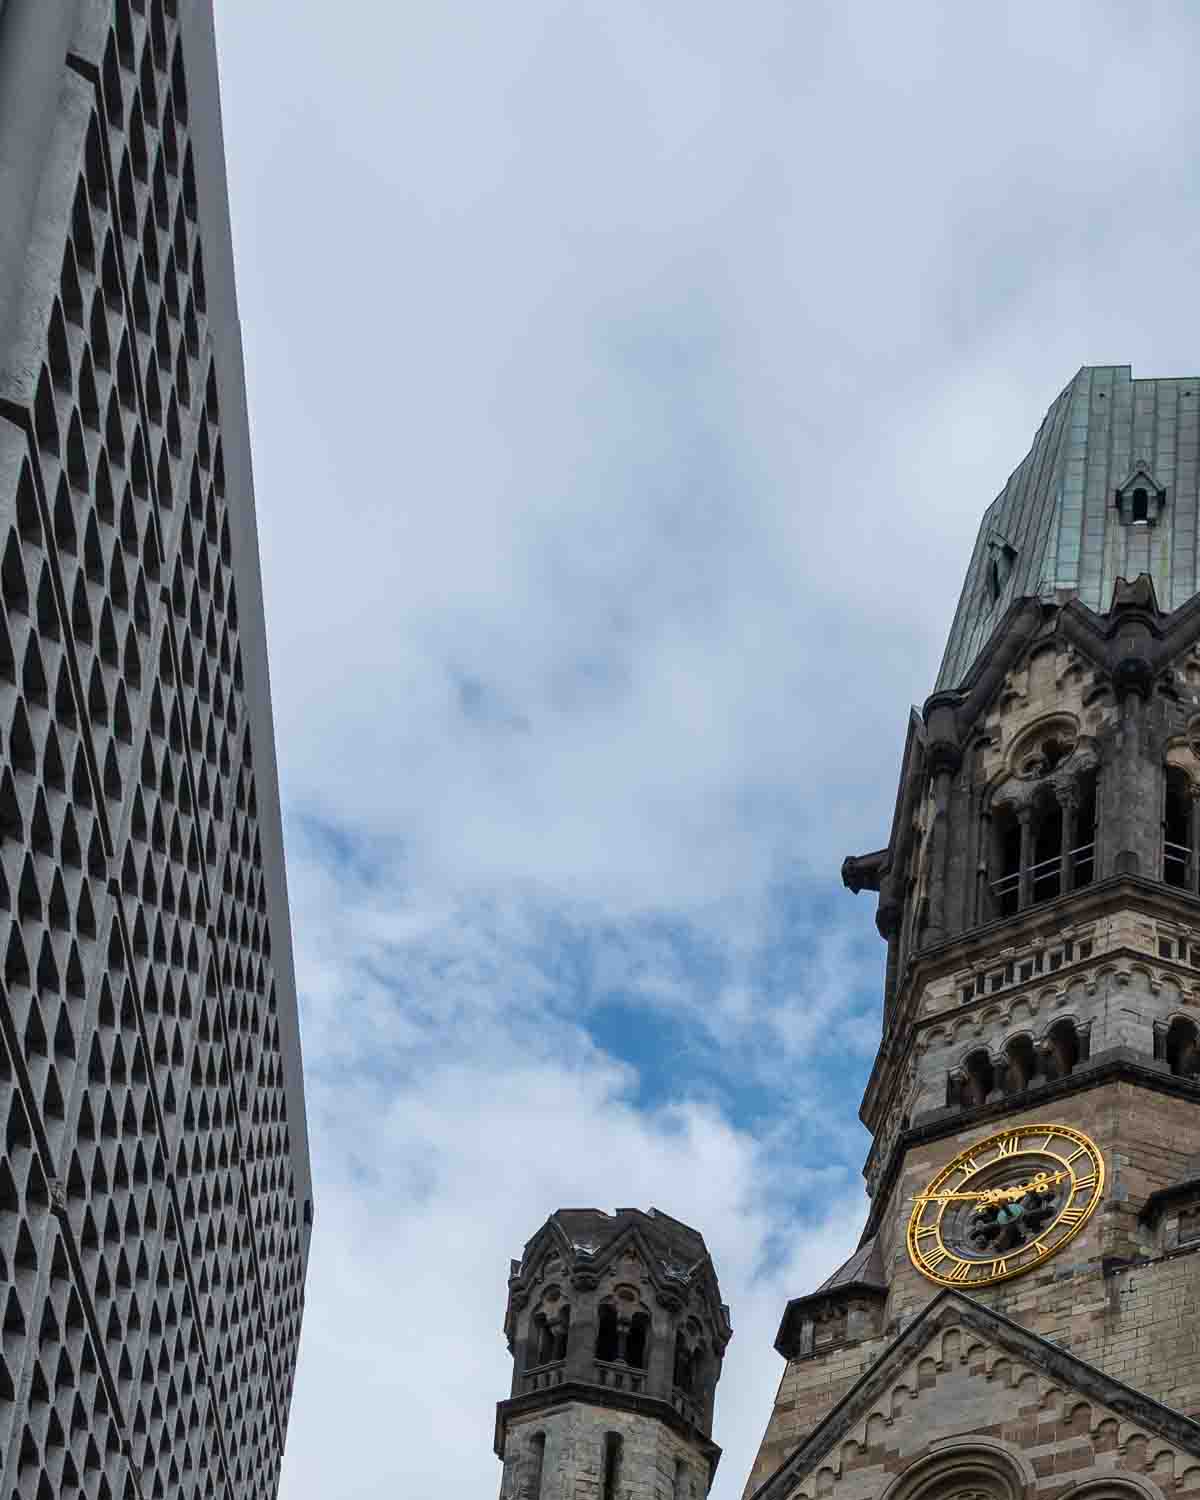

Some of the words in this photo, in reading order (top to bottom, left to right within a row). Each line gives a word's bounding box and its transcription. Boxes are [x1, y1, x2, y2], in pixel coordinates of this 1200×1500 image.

[996, 1135, 1019, 1157] XII
[957, 1157, 979, 1178] XI
[1074, 1173, 1096, 1192] III
